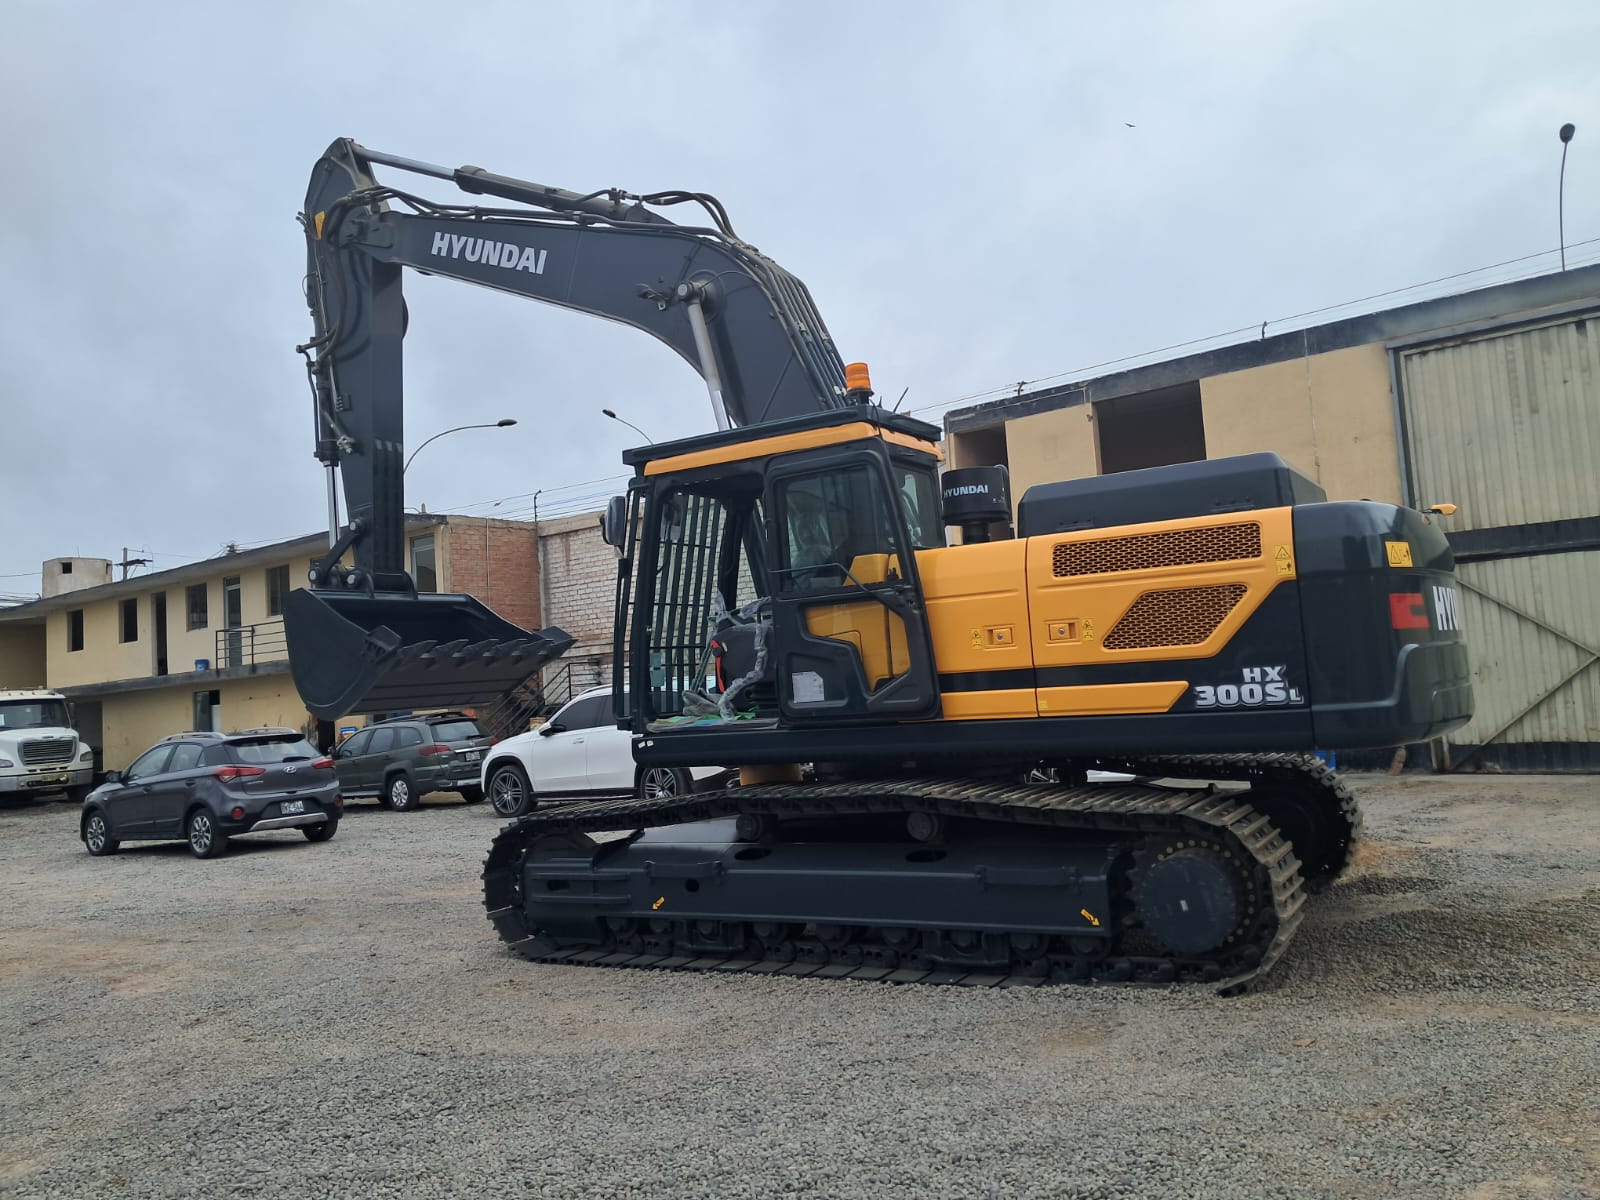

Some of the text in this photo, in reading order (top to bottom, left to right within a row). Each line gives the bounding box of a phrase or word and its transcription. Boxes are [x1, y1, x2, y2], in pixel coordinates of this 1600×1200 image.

[431, 231, 547, 274] HYUNDAI
[944, 484, 988, 498] HYUNDAI
[1242, 665, 1284, 683] HX
